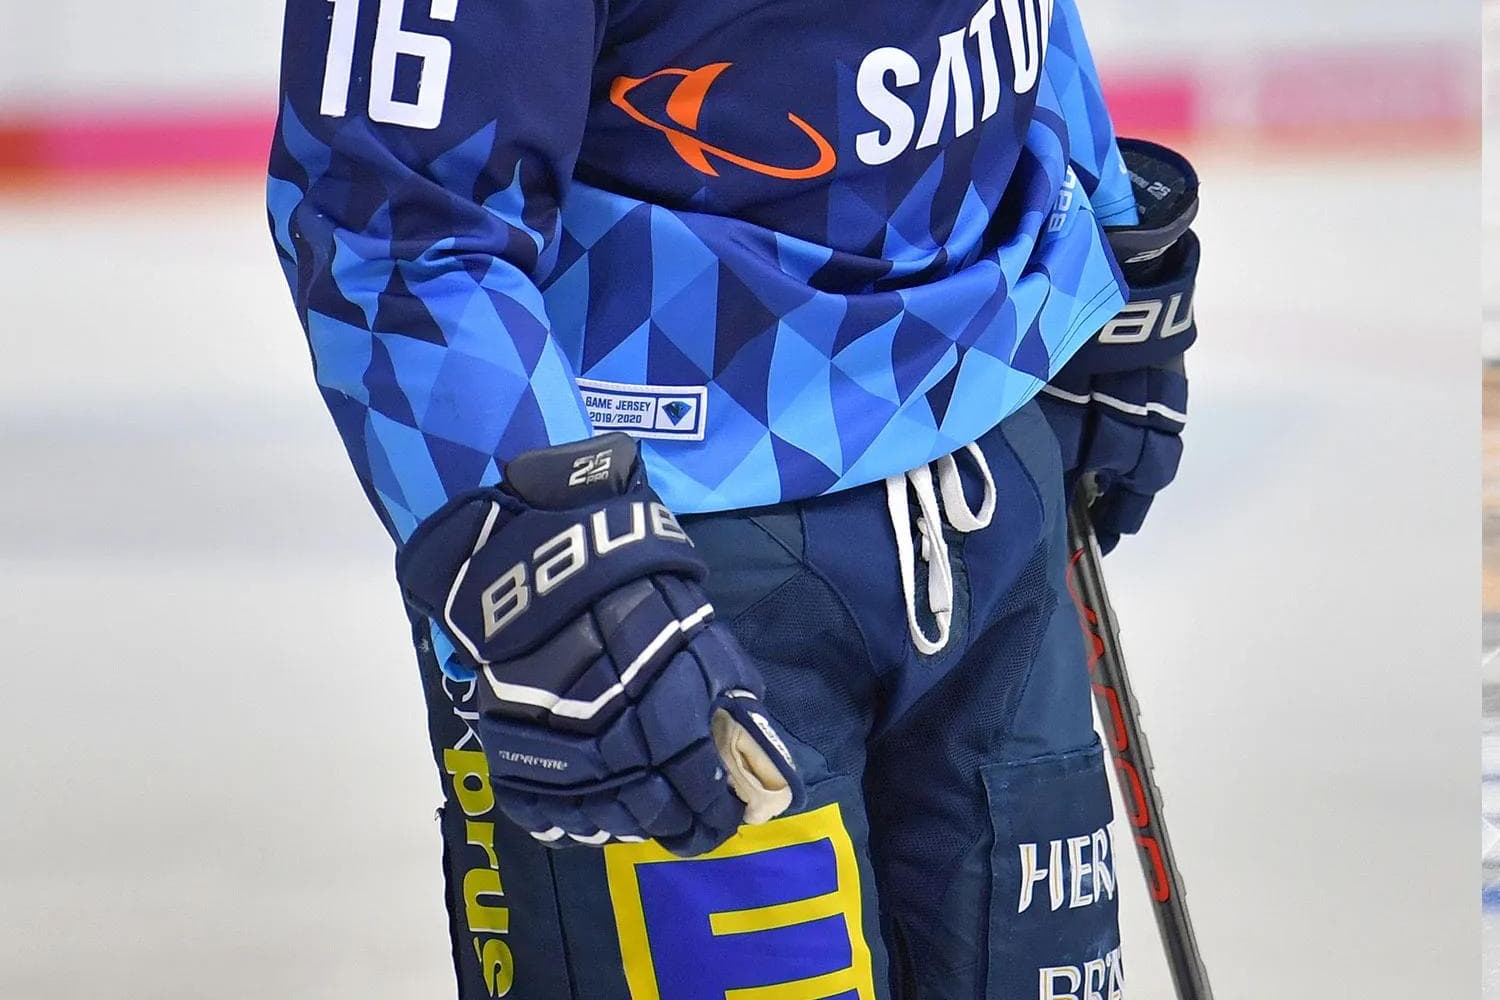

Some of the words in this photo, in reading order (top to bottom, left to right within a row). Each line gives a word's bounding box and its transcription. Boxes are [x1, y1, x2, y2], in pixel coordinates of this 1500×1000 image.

[615, 400, 652, 412] JERSEY
[589, 411, 642, 424] 2019/2020
[481, 502, 694, 643] BAUE
